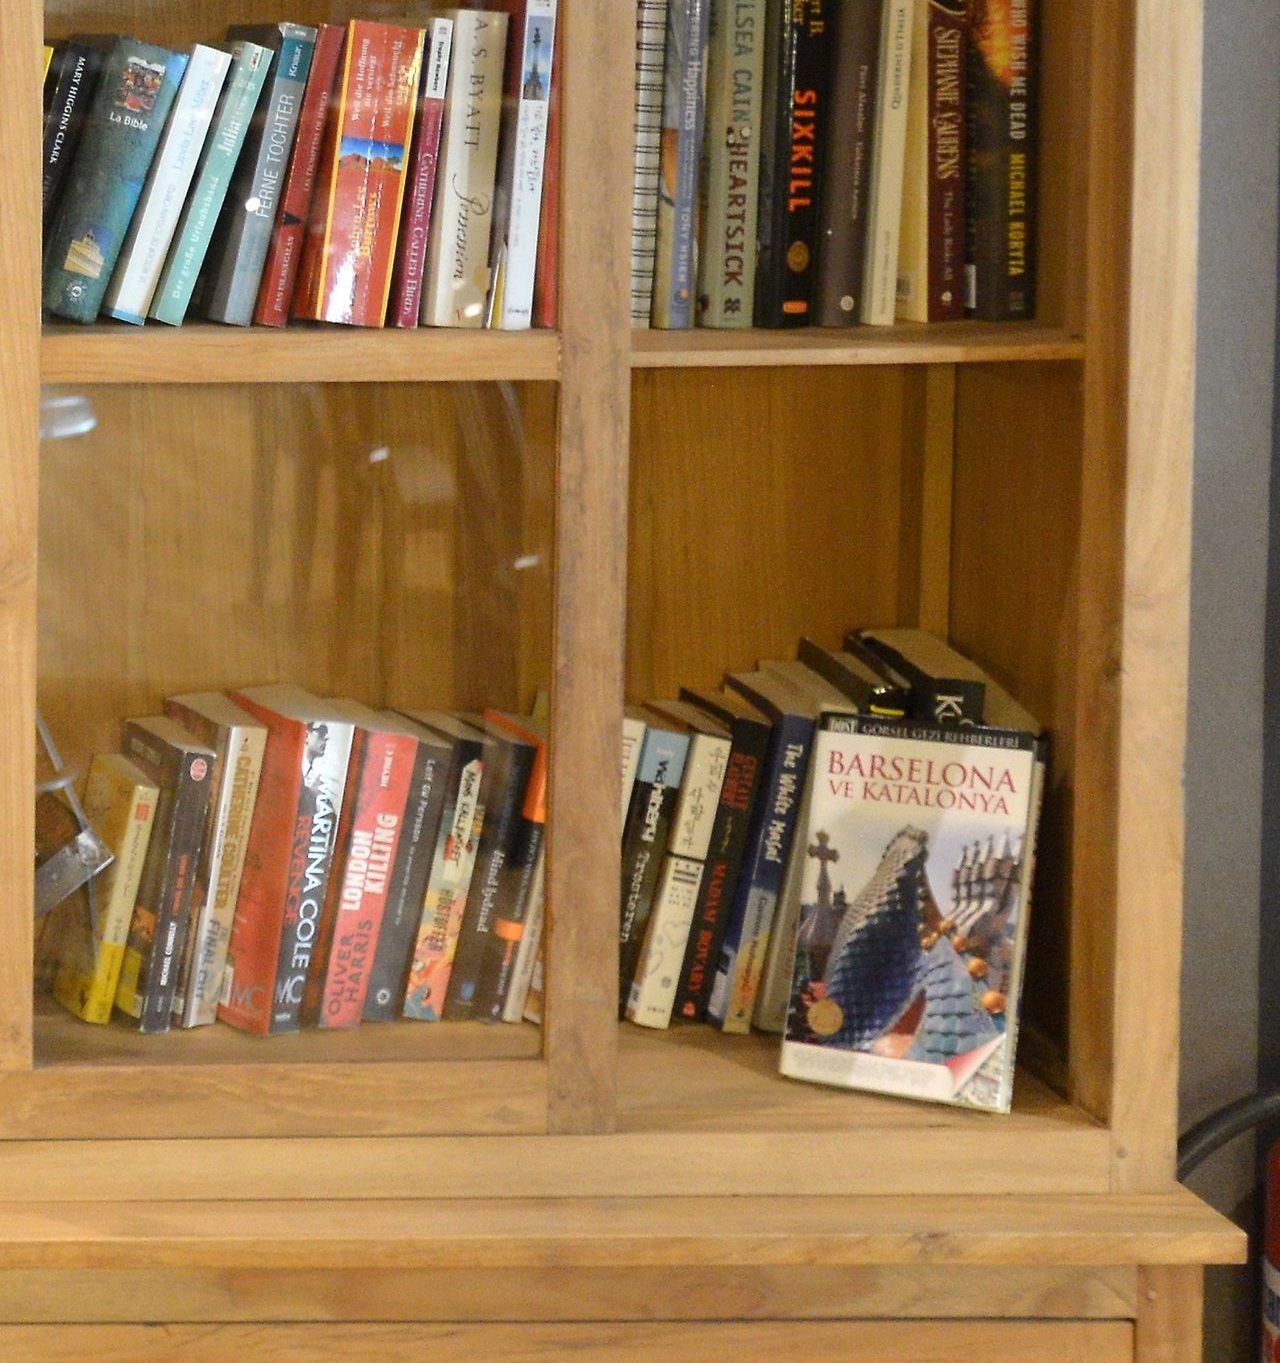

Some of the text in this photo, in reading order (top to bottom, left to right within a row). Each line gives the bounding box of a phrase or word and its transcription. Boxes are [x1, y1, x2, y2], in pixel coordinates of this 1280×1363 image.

[350, 38, 371, 121] Weil die Hoffnung
[1010, 34, 1026, 71] WISH
[50, 56, 85, 163] MARY HIGGINS CLARK
[464, 74, 484, 150] BYATT
[685, 61, 701, 131] Happiness
[733, 69, 753, 129] CAIN
[933, 26, 960, 179] STEPHANIE LAURENS
[1009, 75, 1026, 96] ME
[109, 112, 148, 131] La Bible
[219, 119, 241, 157] Julia
[788, 88, 817, 212] SIXKILL
[1009, 99, 1026, 140] DEAD
[256, 94, 295, 218] FERNE TOCHTER
[1009, 154, 1026, 215] MICHAEL
[680, 206, 691, 241] TONY
[723, 136, 749, 286] HEARTSICK
[410, 226, 424, 276] CALLED
[380, 757, 392, 788] HEYNE
[786, 742, 804, 770] The
[828, 750, 1016, 793] BARSELONA
[775, 772, 797, 817] White
[829, 779, 1009, 815] VE KATALONYA
[287, 815, 311, 923] REVENGE
[292, 774, 338, 969] MARTINA COLE
[342, 830, 373, 911] LONDON
[365, 813, 398, 894] KILLING
[477, 887, 499, 933] lydnad
[329, 932, 354, 1016] OLIVER
[347, 919, 372, 1004] HARRIS
